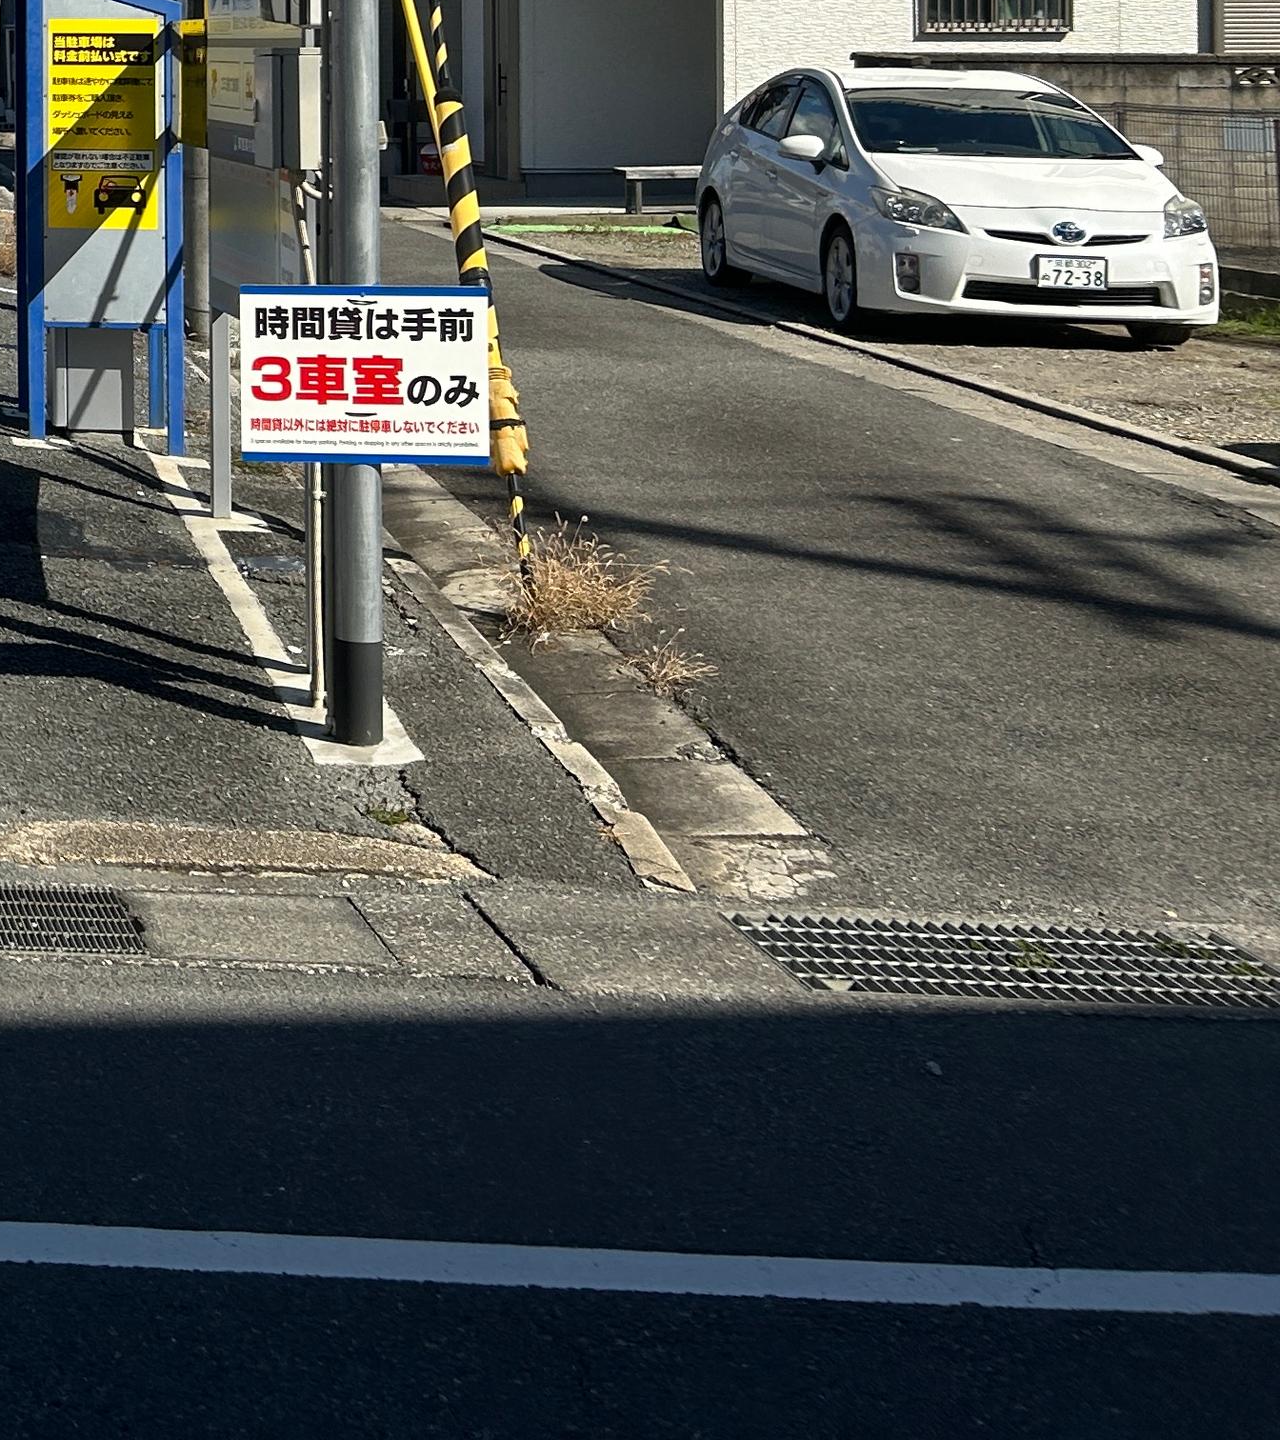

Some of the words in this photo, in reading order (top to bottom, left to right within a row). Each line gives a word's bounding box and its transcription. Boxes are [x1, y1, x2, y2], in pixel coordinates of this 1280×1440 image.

[53, 36, 116, 49] 当駐車場は
[53, 50, 151, 62] 料金前払い式です
[1052, 269, 1103, 287] 72-38
[254, 305, 475, 342] 時間貸は手前
[250, 354, 480, 408] 3車室のみ
[250, 417, 480, 434] 時間貸以外には絶対に駐停車しないでください
